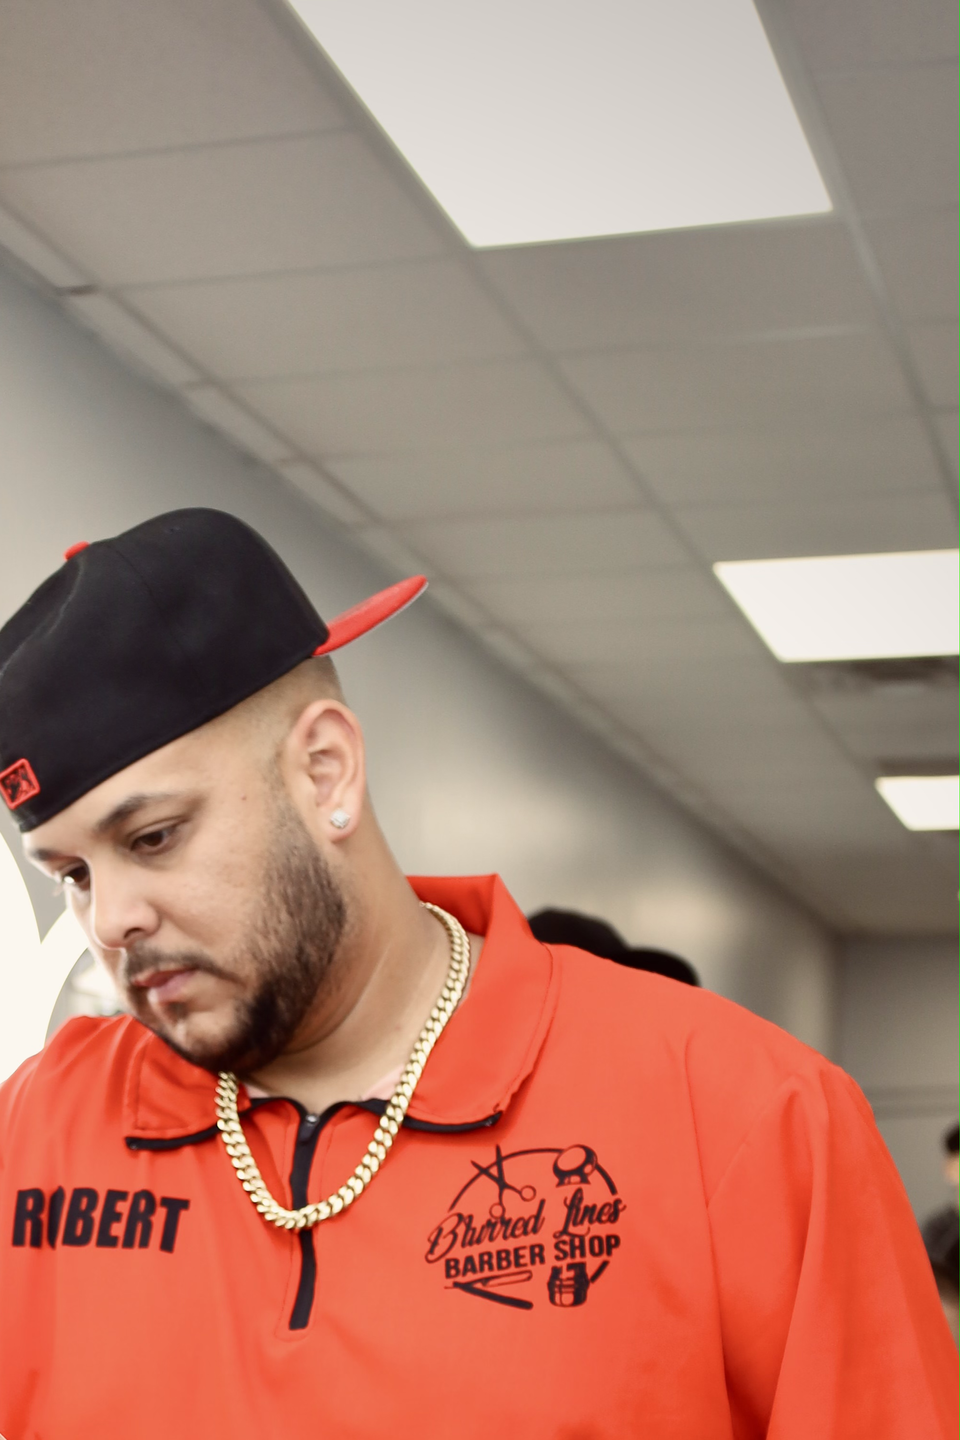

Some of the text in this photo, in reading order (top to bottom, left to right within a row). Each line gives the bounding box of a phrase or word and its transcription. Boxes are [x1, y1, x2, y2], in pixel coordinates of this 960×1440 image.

[425, 1187, 627, 1264] Blurred Lines
[445, 1234, 621, 1279] BARBER SHOP
